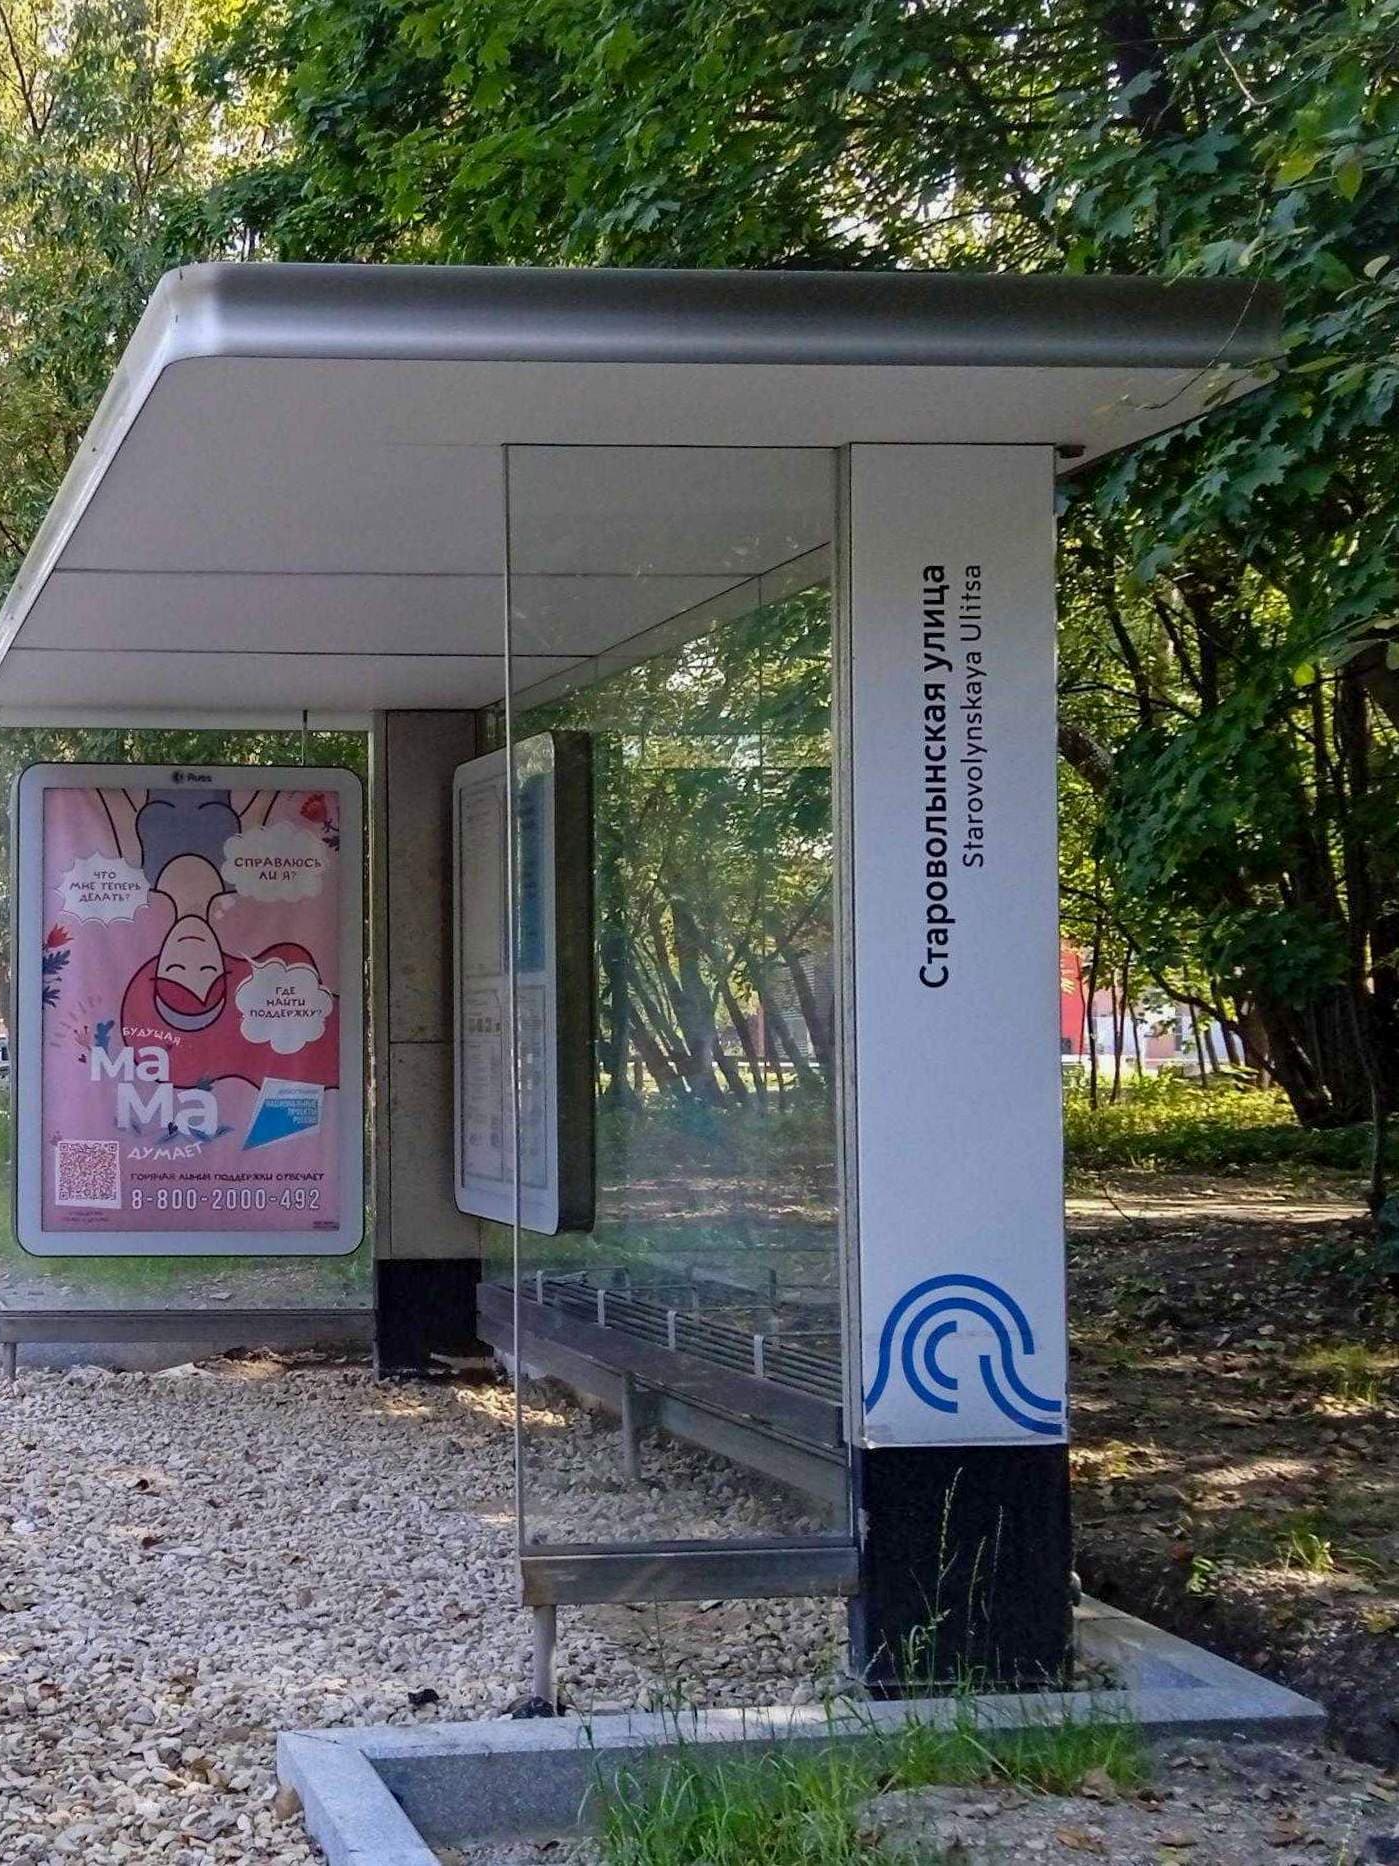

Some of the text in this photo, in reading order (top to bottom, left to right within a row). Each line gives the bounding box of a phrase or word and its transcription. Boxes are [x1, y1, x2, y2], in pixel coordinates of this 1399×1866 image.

[958, 564, 988, 868] Starovolynskaya Ulitsa
[919, 564, 956, 988] Староволынская улица
[233, 856, 322, 868] СПРАВЛЮСЬ
[93, 870, 117, 880] ЧТО
[258, 870, 278, 881] ЛИ
[69, 881, 142, 891] МНЕ ТЕПЕРЬ
[78, 892, 131, 903] ДЕЛАТЬ?
[275, 986, 296, 996] ГДЕ
[122, 1026, 182, 1046] БУДУЩАЯ
[127, 1141, 203, 1161] ДУМАЕТ
[131, 1188, 321, 1210] 8-800-2000-492
